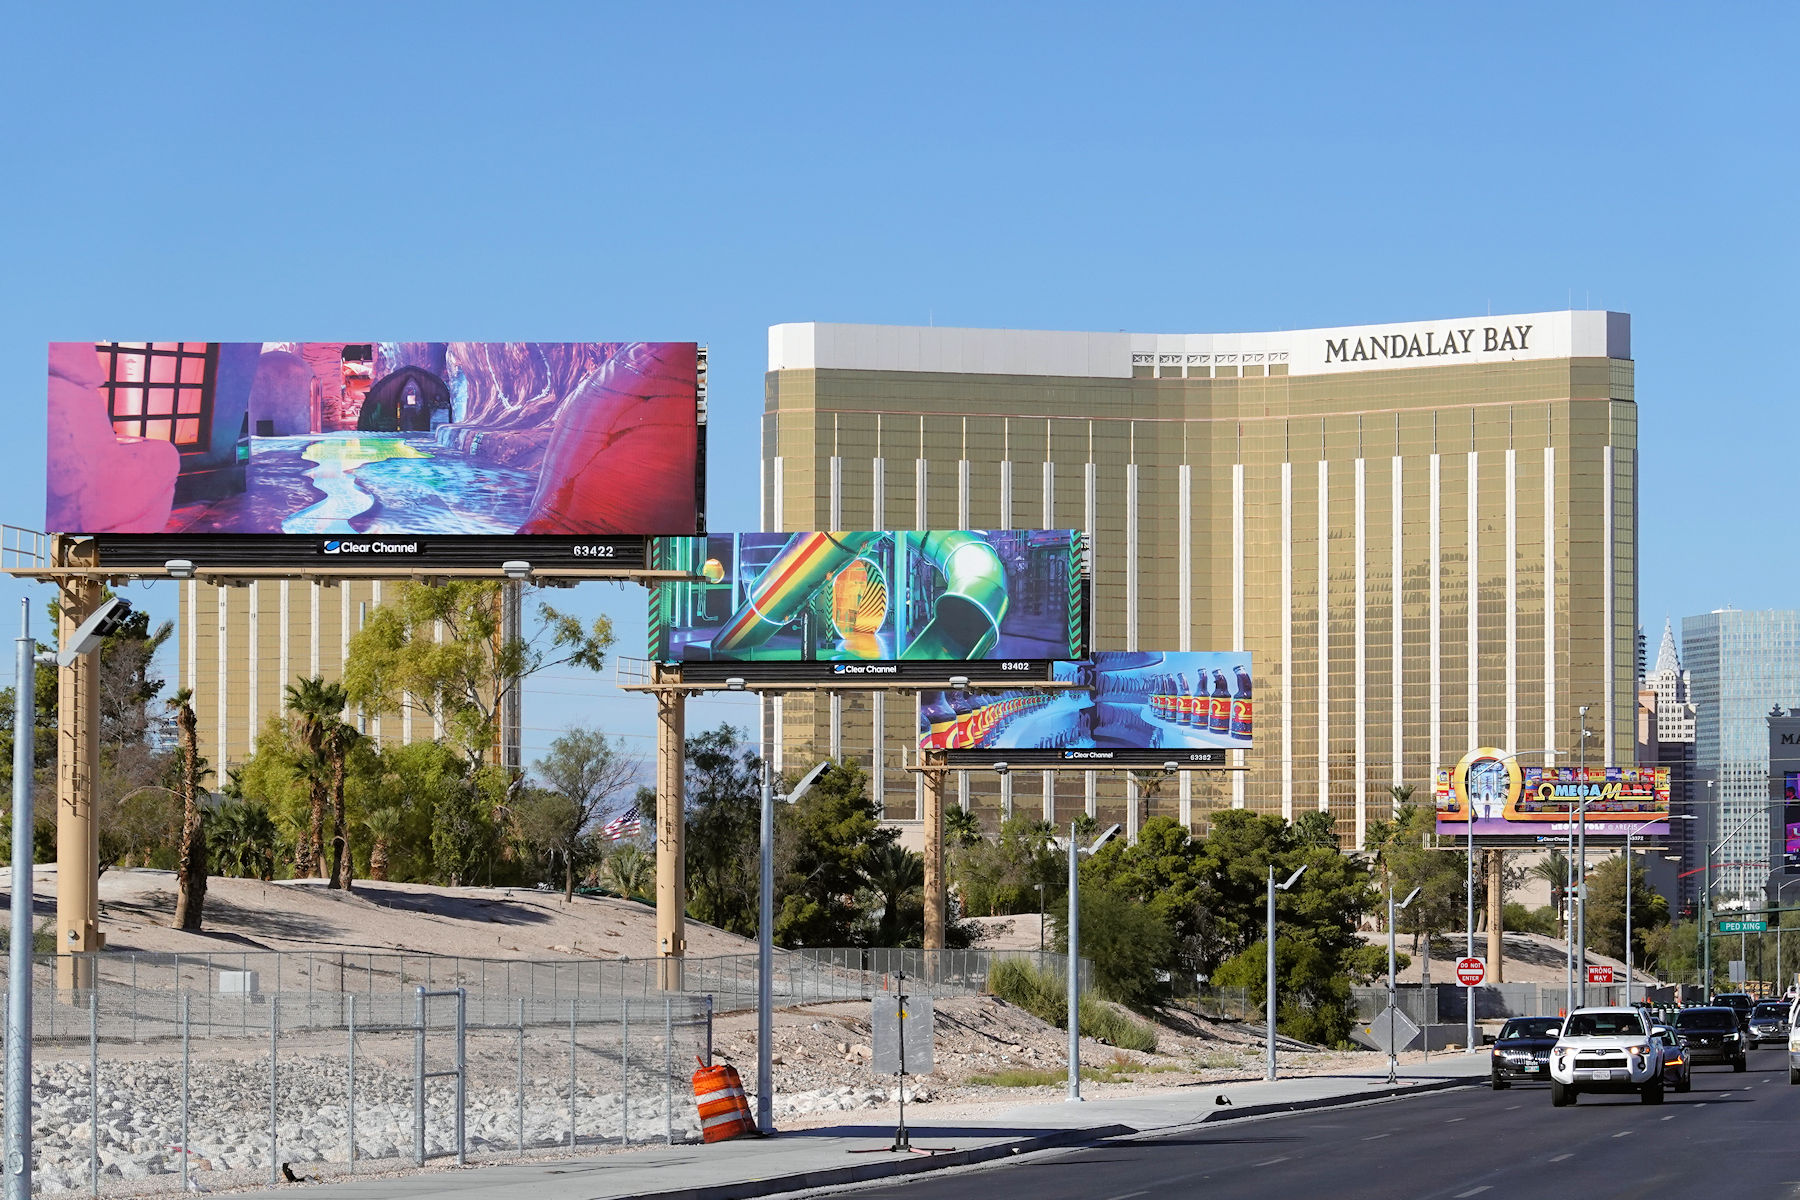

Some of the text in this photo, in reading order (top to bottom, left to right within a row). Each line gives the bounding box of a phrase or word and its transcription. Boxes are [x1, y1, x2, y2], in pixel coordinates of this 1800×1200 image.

[1324, 325, 1533, 363] MANDALAY BAY
[341, 542, 418, 554] Clear Channel
[573, 545, 614, 557] 63422
[846, 665, 897, 674] Clear Channel
[1002, 663, 1029, 671] 63402
